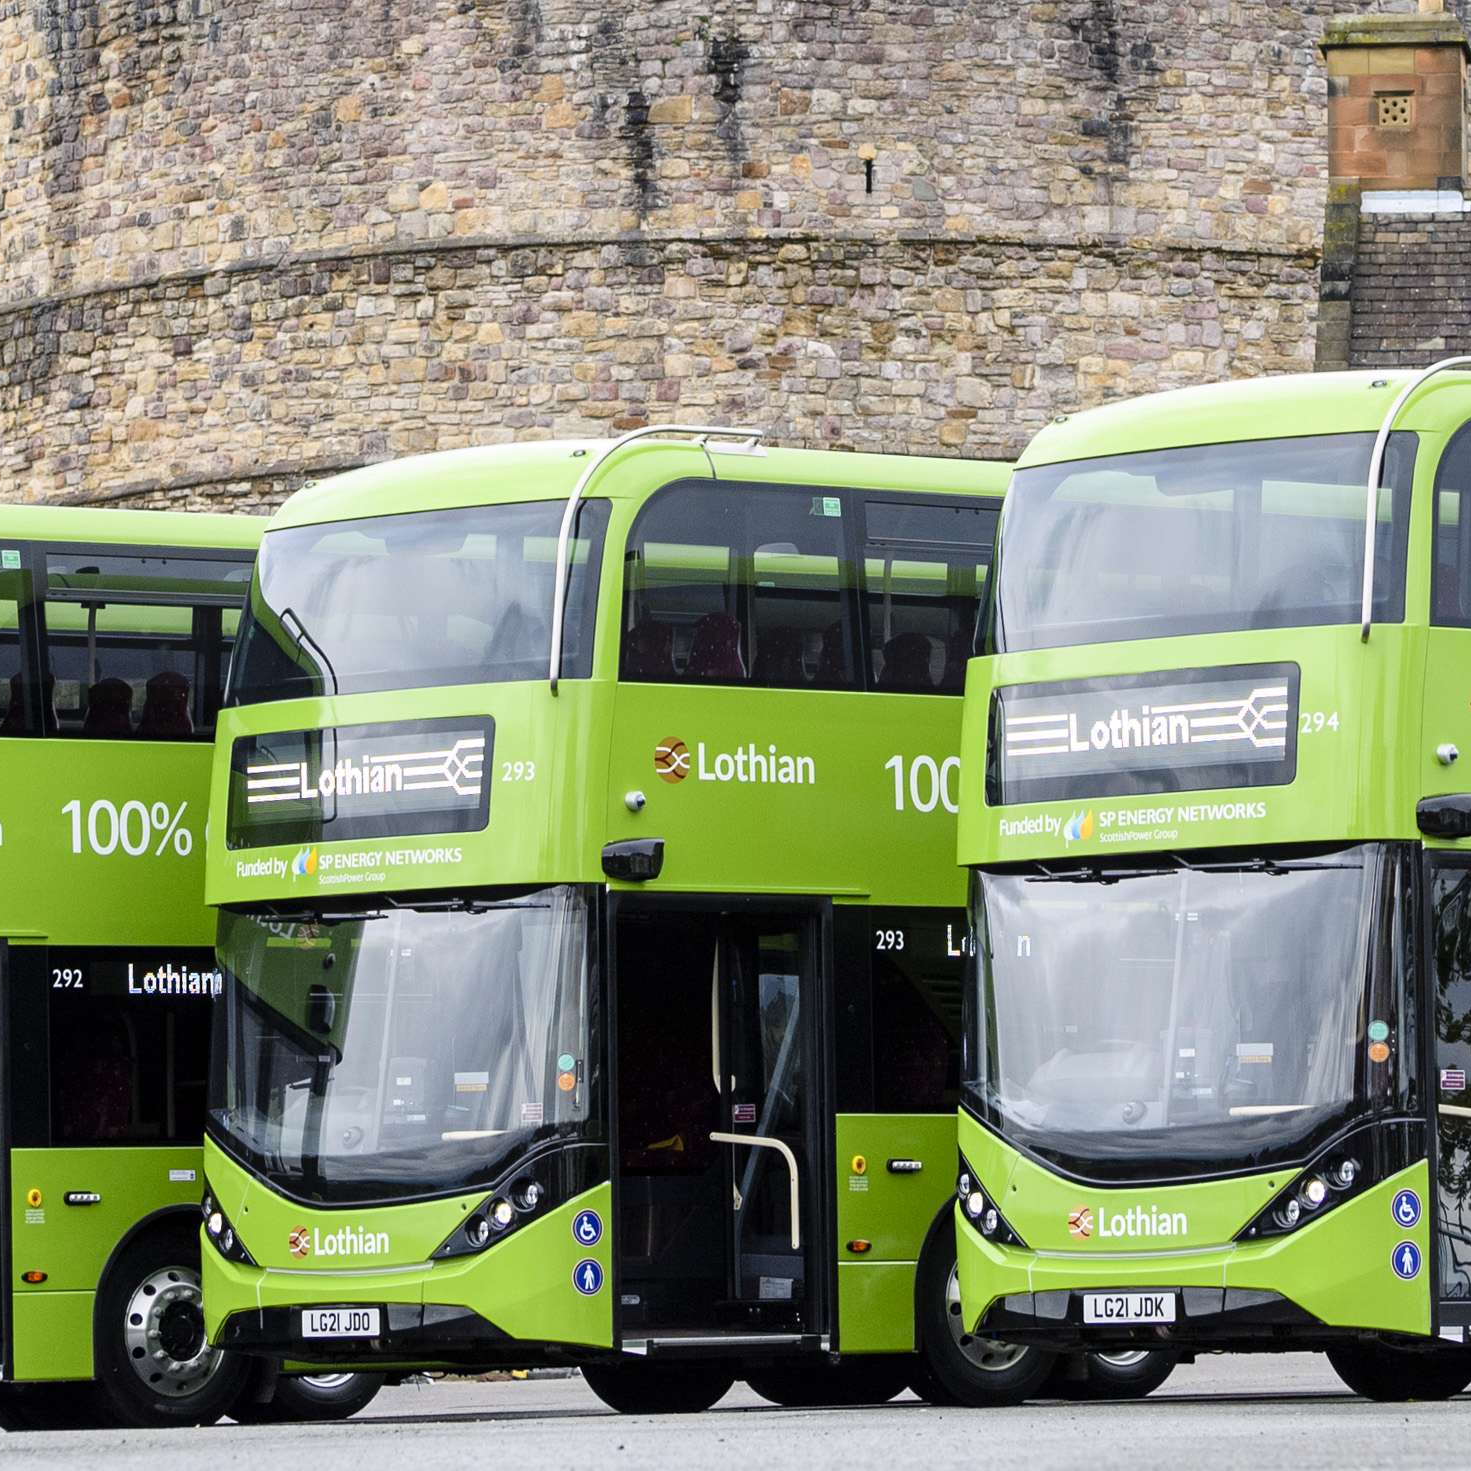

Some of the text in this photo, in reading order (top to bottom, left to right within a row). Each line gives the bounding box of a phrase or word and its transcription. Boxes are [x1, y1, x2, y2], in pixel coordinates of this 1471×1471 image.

[1068, 705, 1191, 753] Lothian
[1300, 711, 1340, 734] 294
[300, 755, 404, 799] Lothian
[501, 761, 535, 782] 293
[698, 742, 815, 784] Lothian
[61, 800, 192, 856] 100%
[999, 802, 1267, 837] Funded by SP ENERGY NETWORKS
[1099, 829, 1178, 843] ScottishPower Group
[236, 848, 462, 879] Funded by SP ENERGY NETWORKS
[319, 871, 386, 885] ScottishPower Group
[876, 930, 904, 950] 293
[52, 968, 83, 988] 292
[128, 963, 214, 994] Lothian
[1099, 1205, 1187, 1237] Lothian
[314, 1225, 390, 1256] Lothian
[311, 1312, 370, 1332] LG21 JDO
[1094, 1297, 1164, 1318] LG21 JDK
